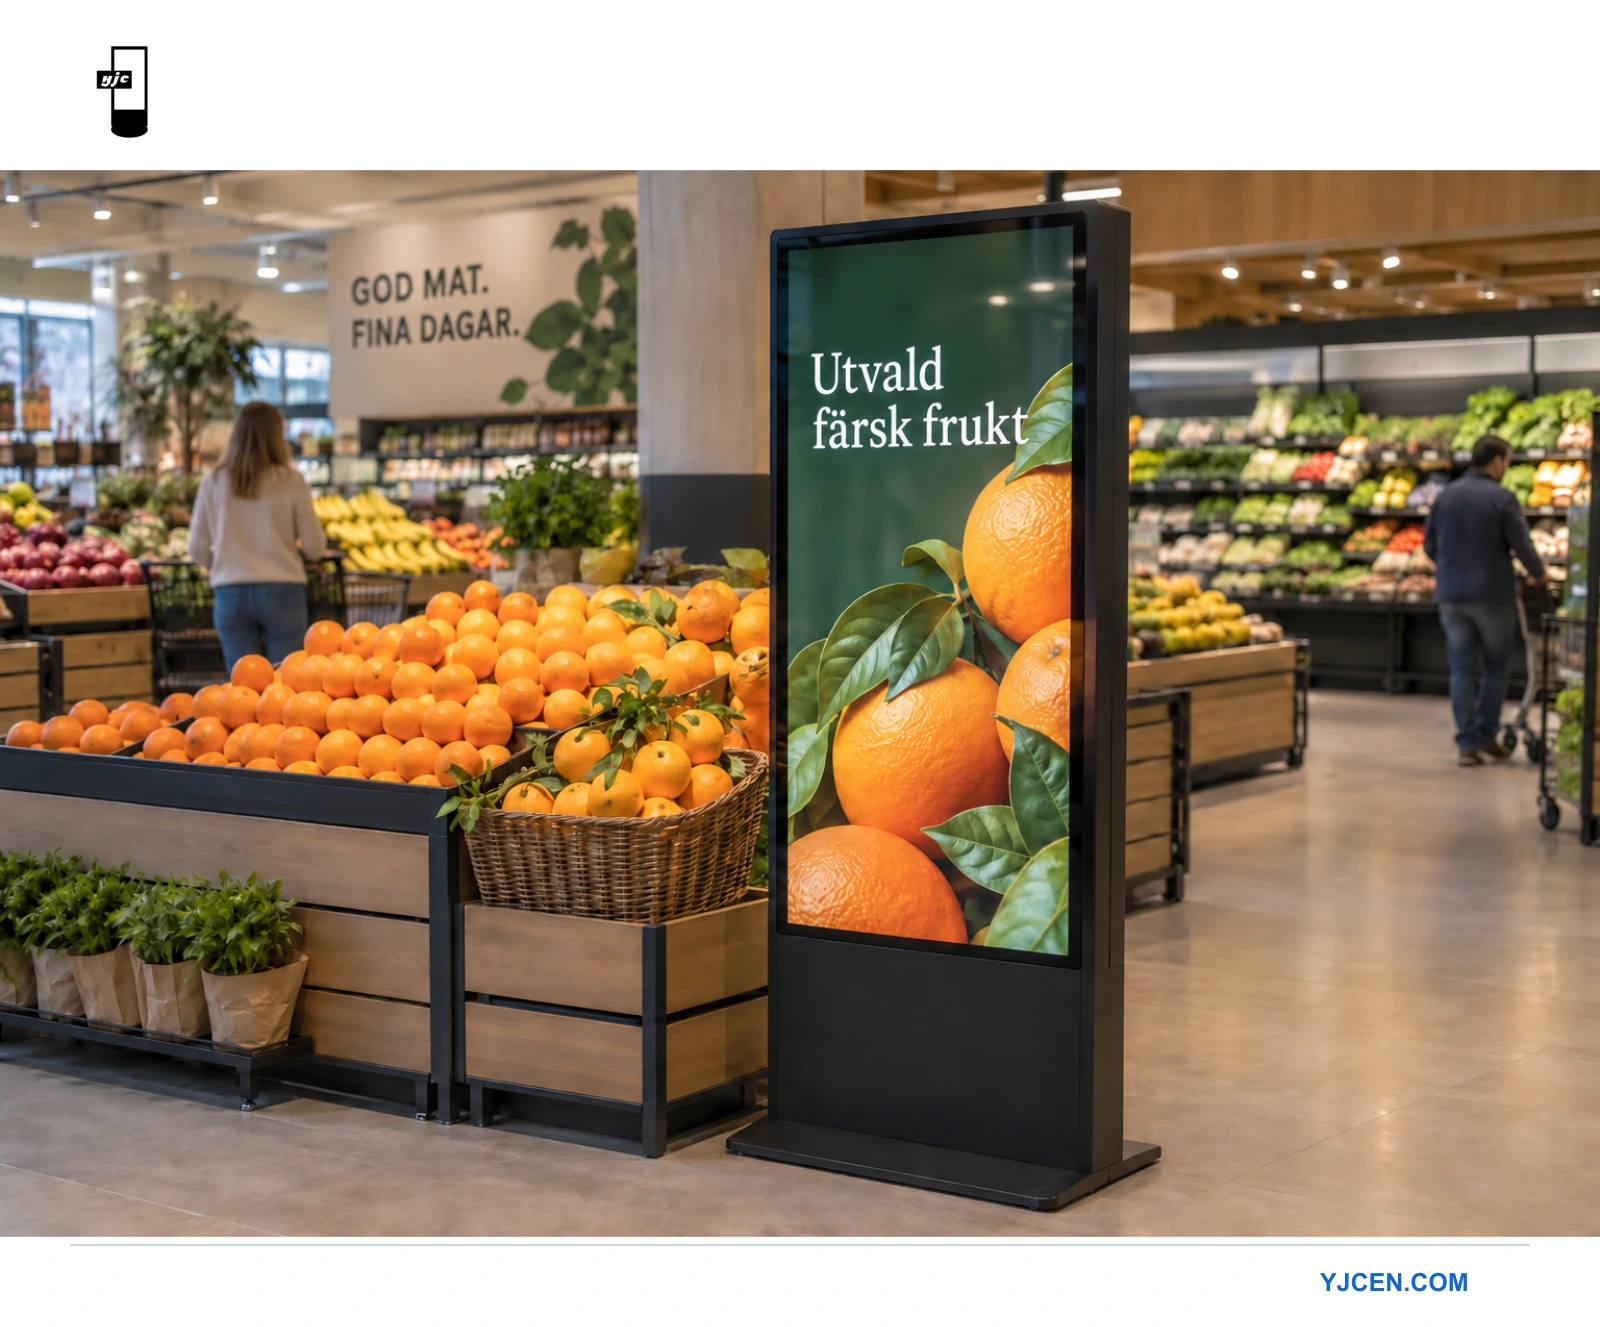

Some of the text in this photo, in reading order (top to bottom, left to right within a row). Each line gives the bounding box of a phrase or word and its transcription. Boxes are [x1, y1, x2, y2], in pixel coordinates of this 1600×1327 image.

[351, 263, 489, 307] GOD MAT.
[352, 307, 520, 348] FINA DAGAR.
[811, 345, 944, 395] Utvald
[813, 400, 1029, 450] färsk frukt
